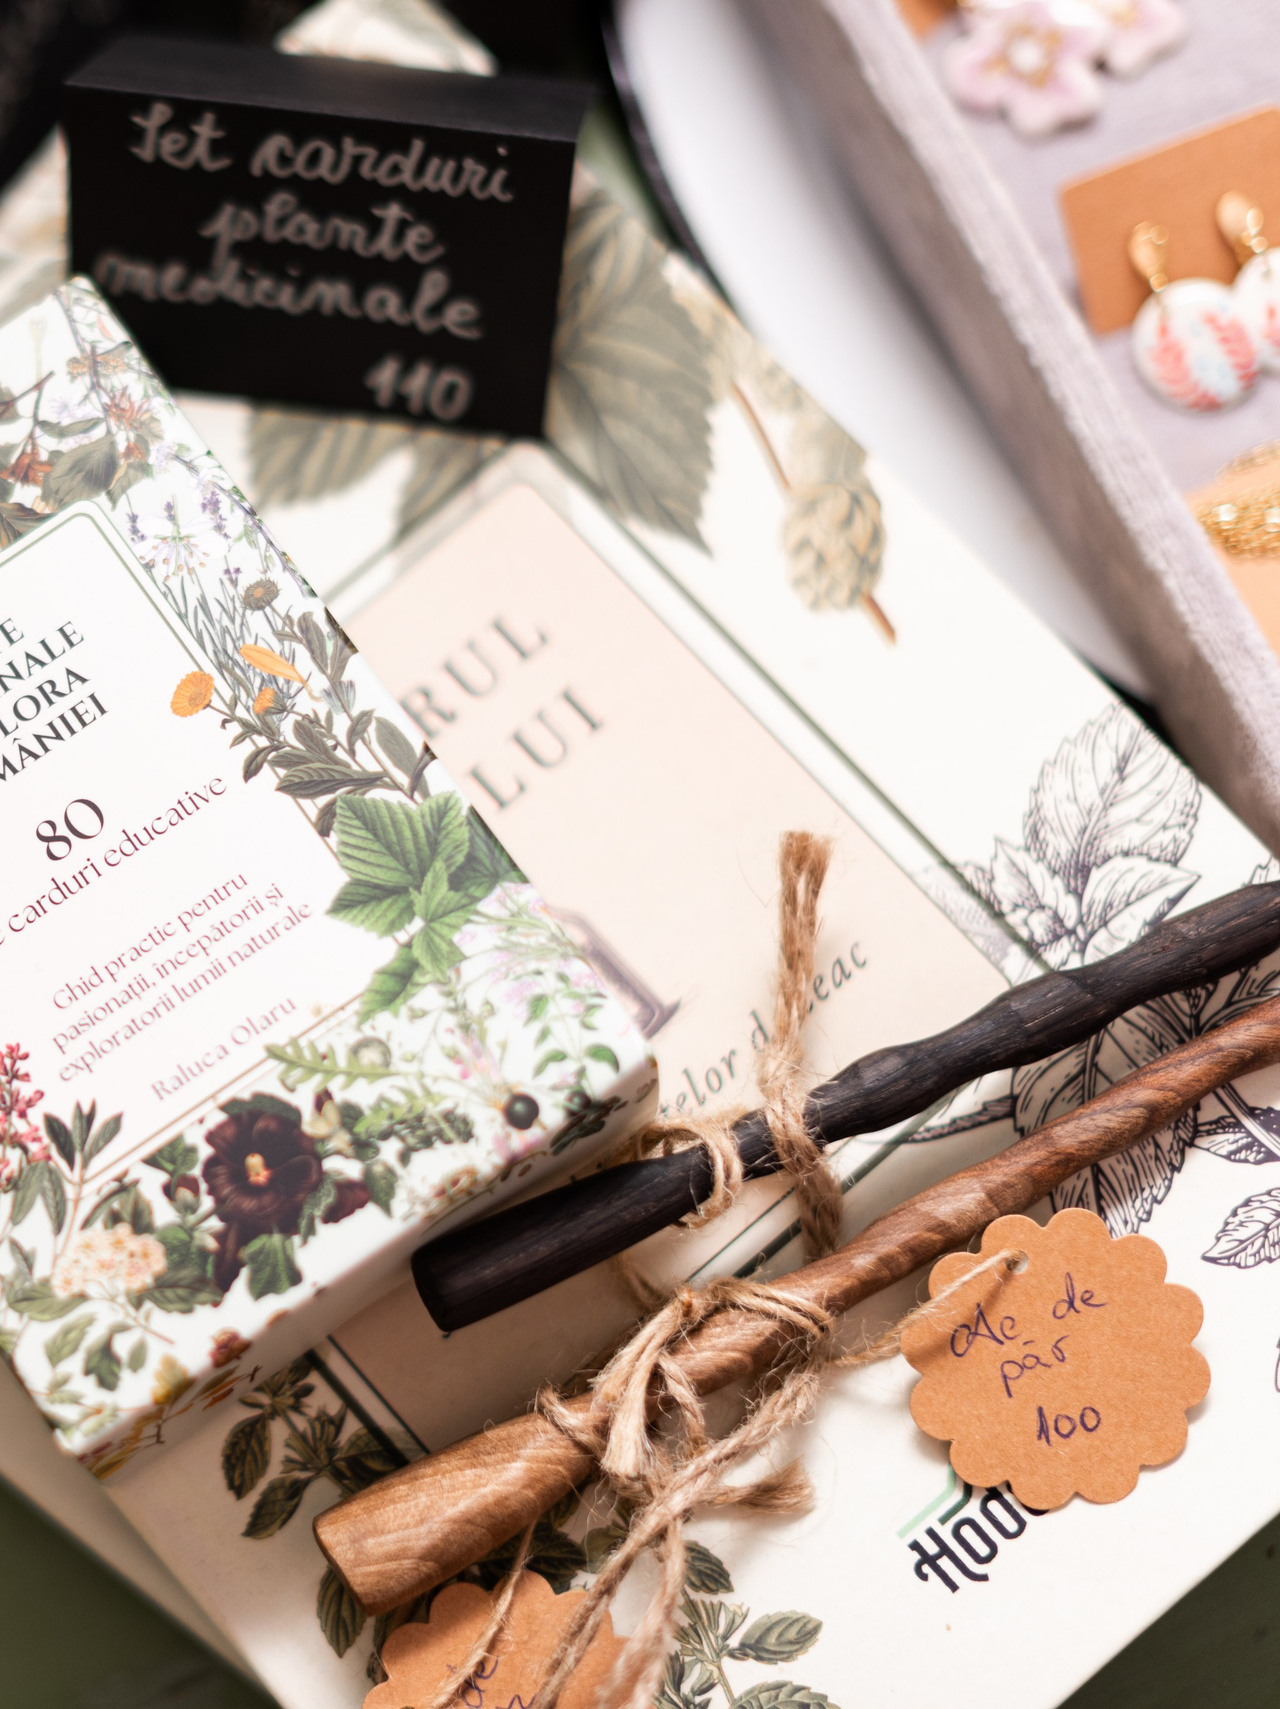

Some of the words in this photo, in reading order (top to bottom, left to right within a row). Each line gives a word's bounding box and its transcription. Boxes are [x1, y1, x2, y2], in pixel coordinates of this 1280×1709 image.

[129, 102, 233, 172] Set
[249, 135, 515, 203] carduri
[198, 192, 446, 273] plante
[92, 252, 483, 341] medicinale
[362, 352, 473, 422] 110
[8, 858, 103, 932] carduri
[104, 778, 227, 867] educative
[35, 798, 105, 861] 80
[52, 966, 104, 1009] Ghid
[104, 922, 176, 982] practic
[177, 874, 248, 932] pentru
[152, 896, 265, 979] începătorii
[265, 883, 284, 907] și
[58, 993, 176, 1082] exploratorii
[171, 958, 228, 1003] lumii
[227, 903, 313, 968] naturale
[151, 1044, 230, 1101] Raluca
[230, 998, 297, 1046] Olaru
[1052, 1272, 1109, 1320] de
[1037, 1406, 1101, 1447] 100
